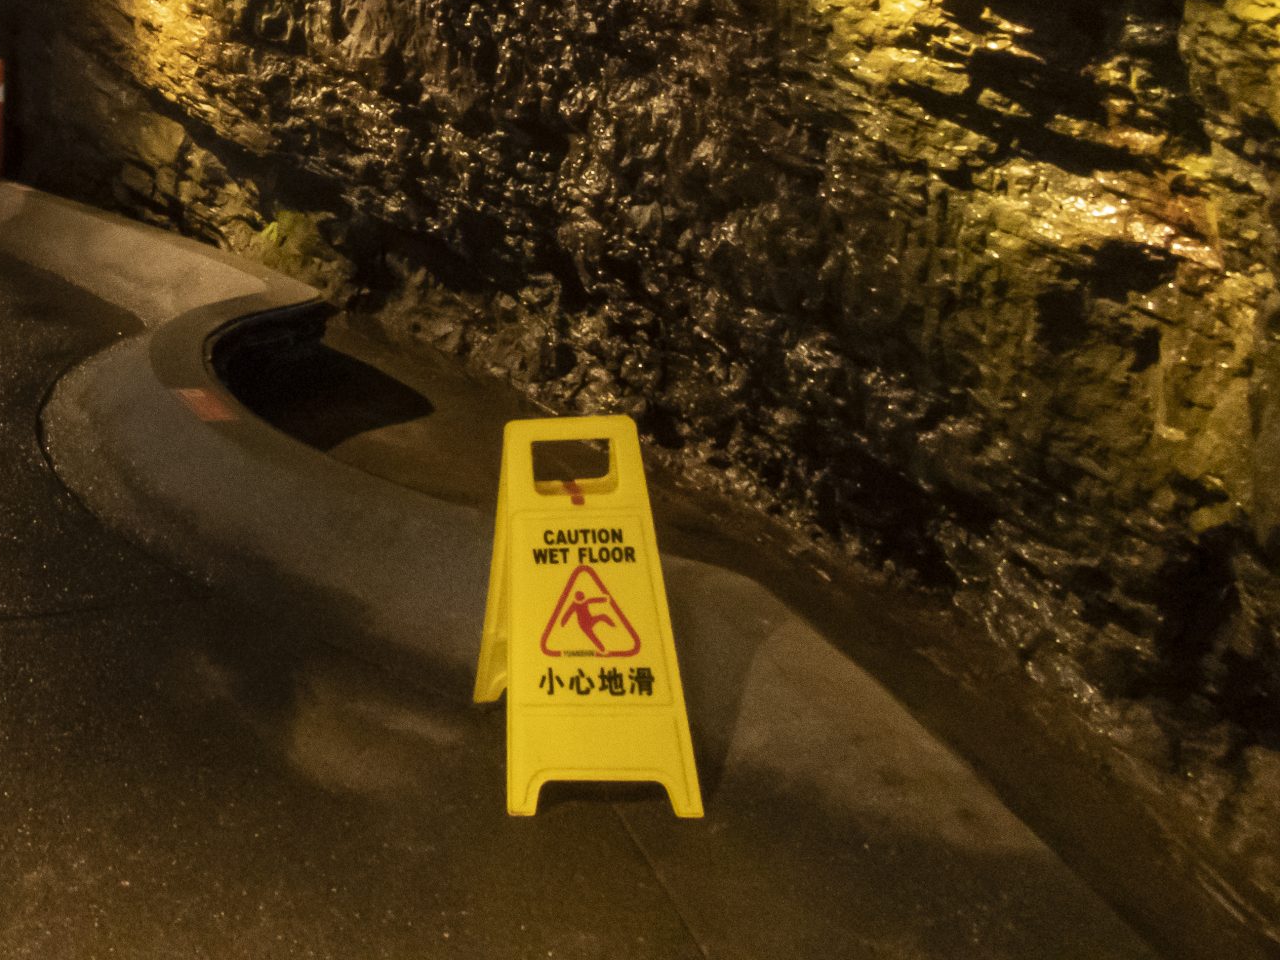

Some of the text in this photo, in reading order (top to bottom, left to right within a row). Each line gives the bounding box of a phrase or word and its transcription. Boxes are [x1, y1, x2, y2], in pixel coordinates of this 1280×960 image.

[544, 528, 623, 545] CAUTION
[533, 546, 636, 564] WET FLOOR
[539, 667, 655, 696] 小心地滑
